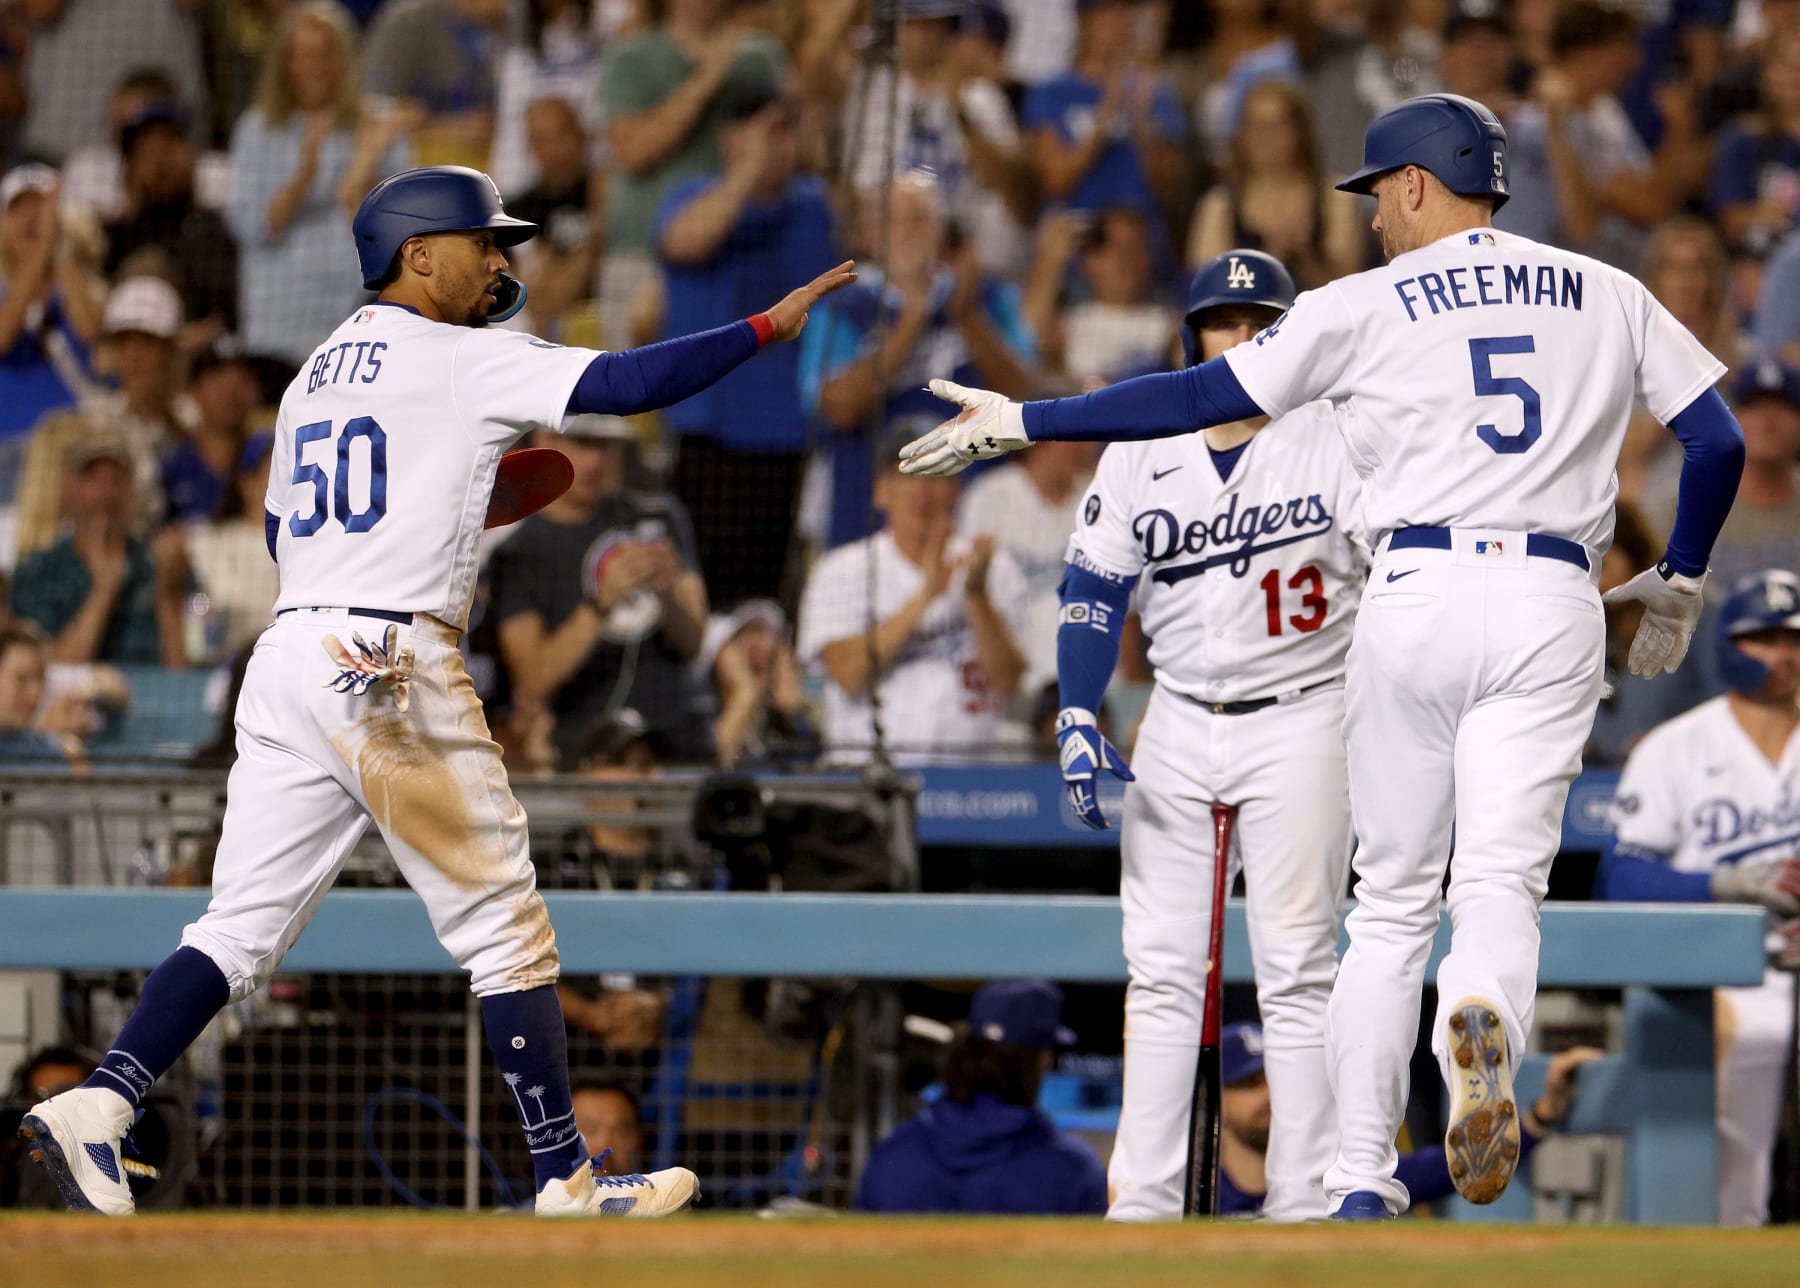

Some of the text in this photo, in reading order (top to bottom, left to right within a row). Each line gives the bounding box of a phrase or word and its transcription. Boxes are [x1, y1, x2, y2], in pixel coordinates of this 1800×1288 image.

[1493, 151, 1503, 177] 5
[1227, 257, 1255, 288] LA
[1394, 265, 1582, 322] FREEMAN
[307, 342, 387, 395] BETTS
[1468, 335, 1542, 454] 5
[289, 415, 387, 538] 50
[1133, 493, 1333, 579] Dodgers
[1260, 565, 1328, 637] 13
